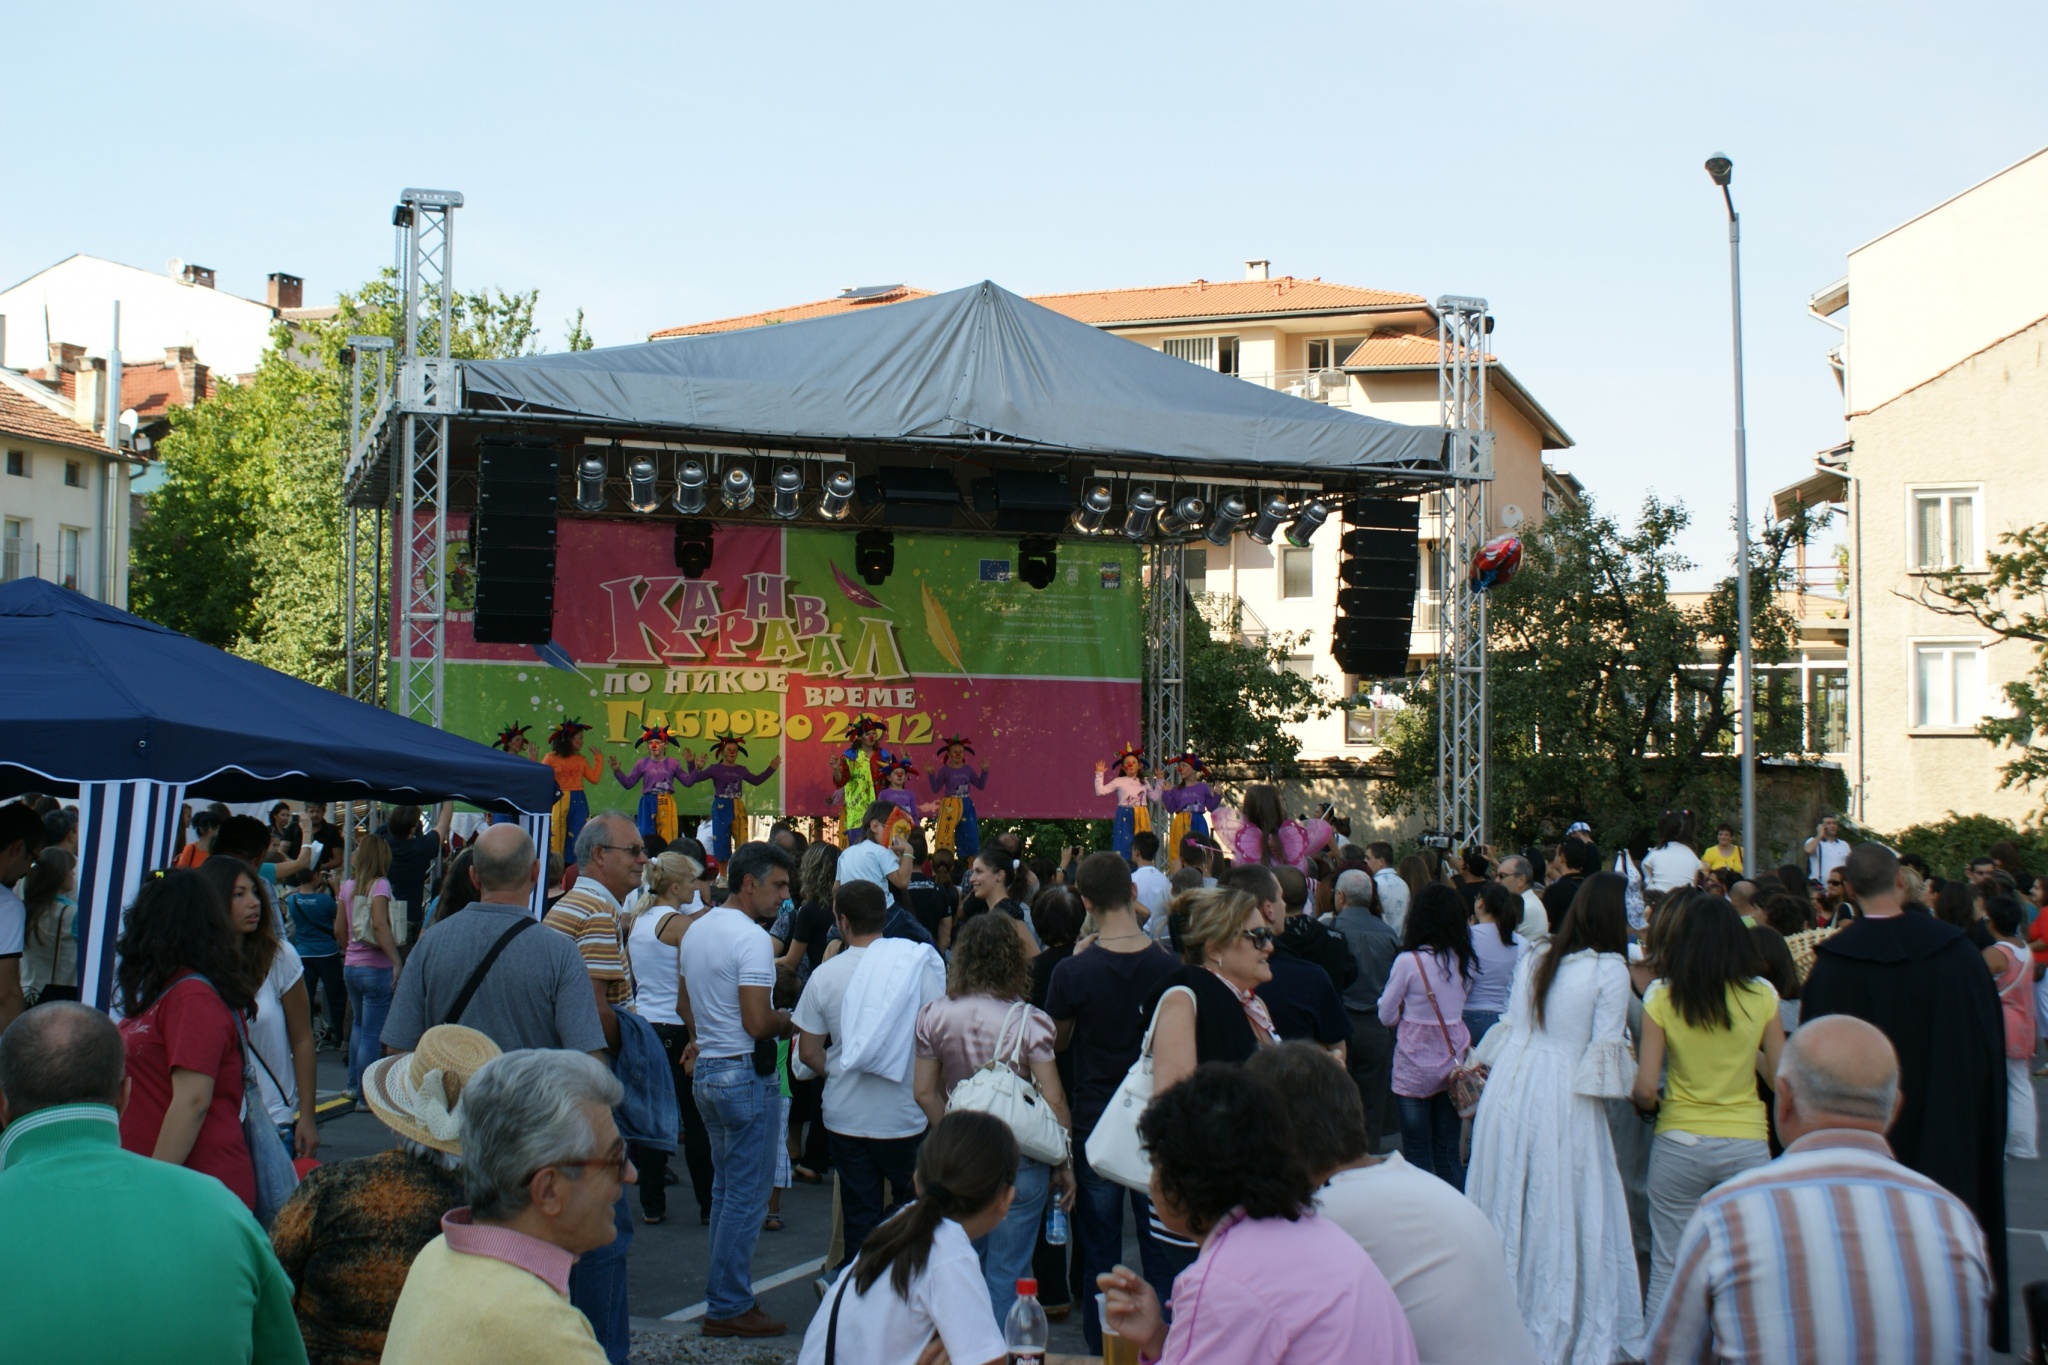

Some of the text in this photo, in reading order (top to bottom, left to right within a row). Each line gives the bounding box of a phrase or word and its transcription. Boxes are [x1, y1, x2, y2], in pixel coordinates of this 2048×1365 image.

[602, 670, 789, 694] ПО НИКОЕ
[803, 686, 916, 708] ВРЕМЕ
